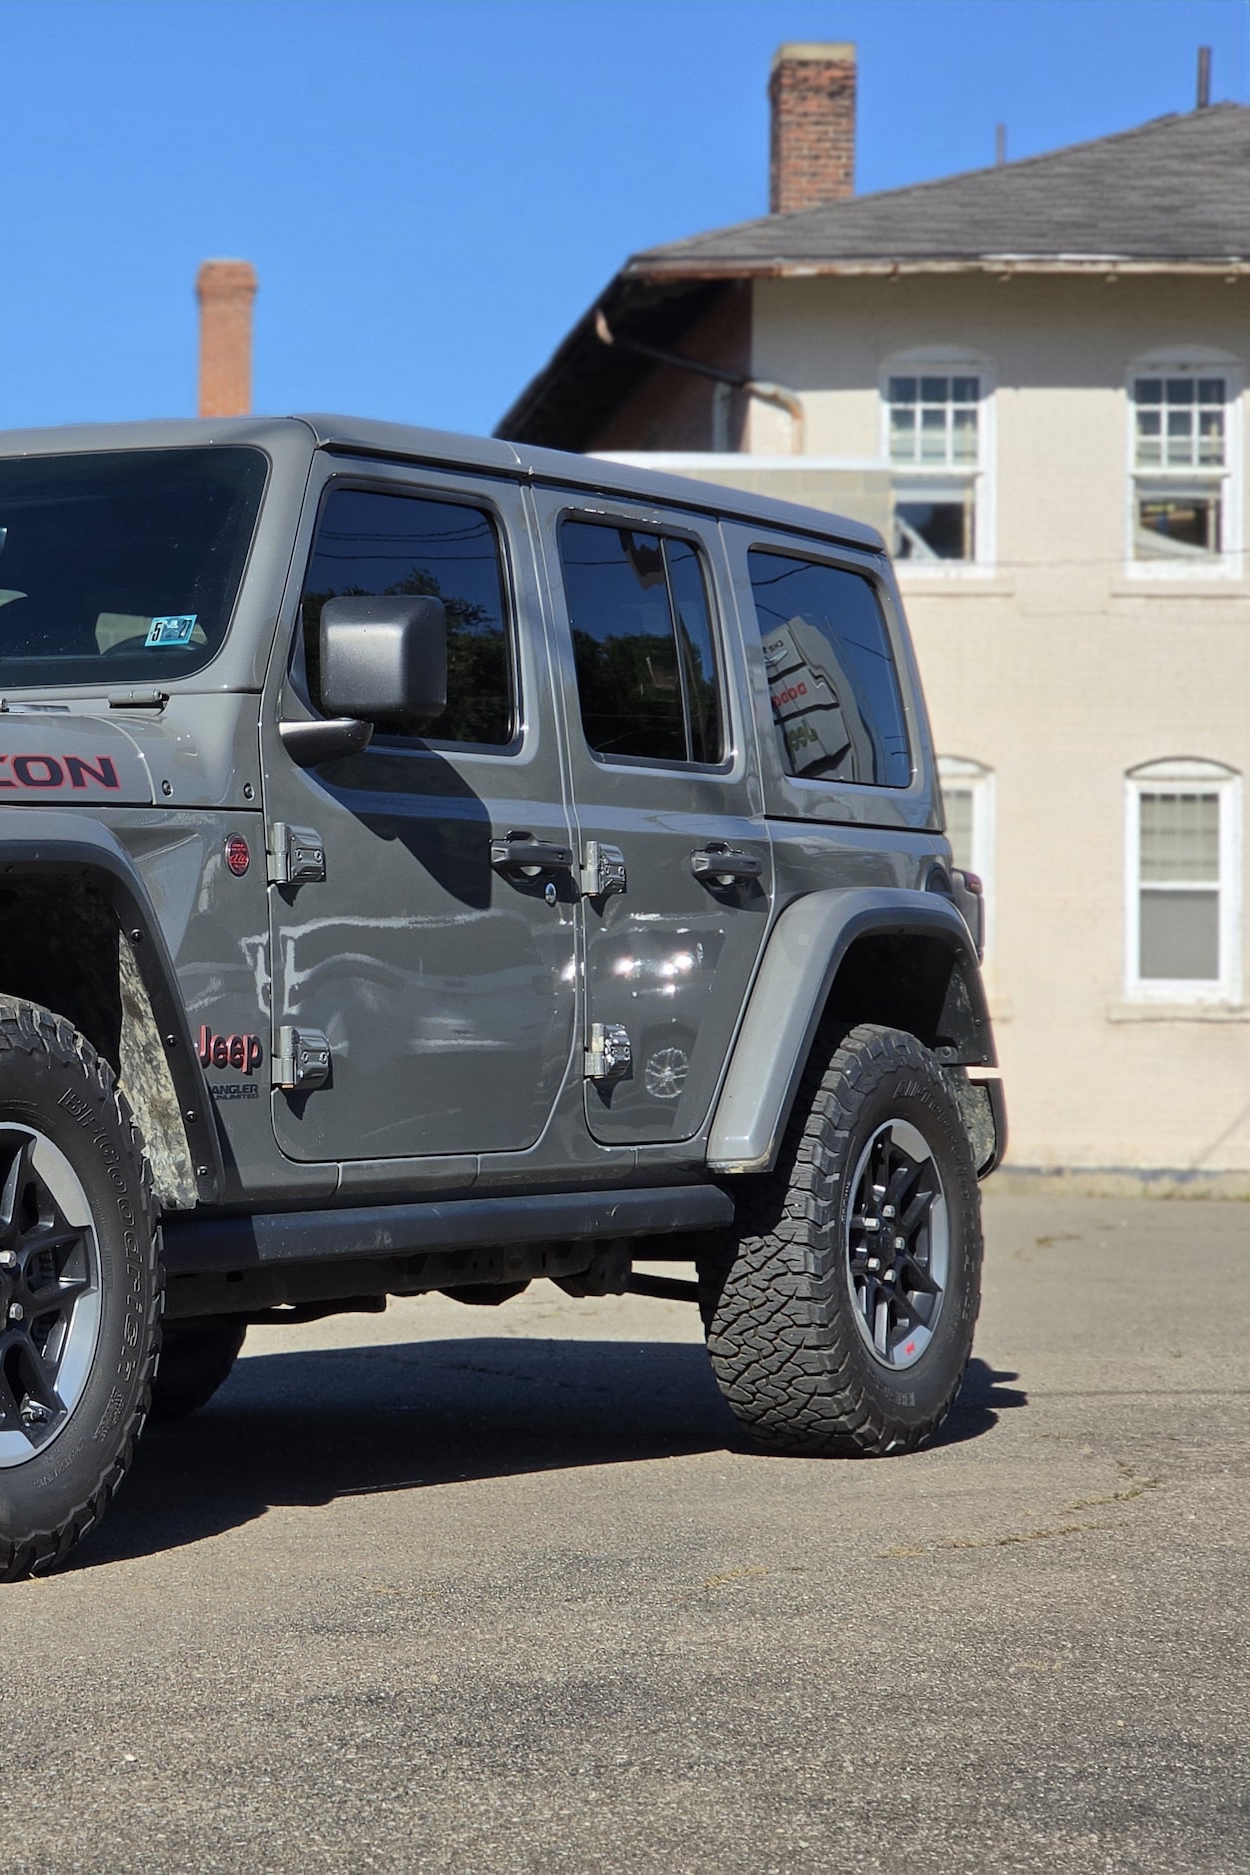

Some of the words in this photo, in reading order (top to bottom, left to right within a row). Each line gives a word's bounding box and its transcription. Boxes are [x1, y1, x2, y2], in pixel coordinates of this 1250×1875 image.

[151, 622, 162, 641] 5
[199, 1024, 264, 1076] Jeep
[212, 1084, 259, 1095] ANGLER
